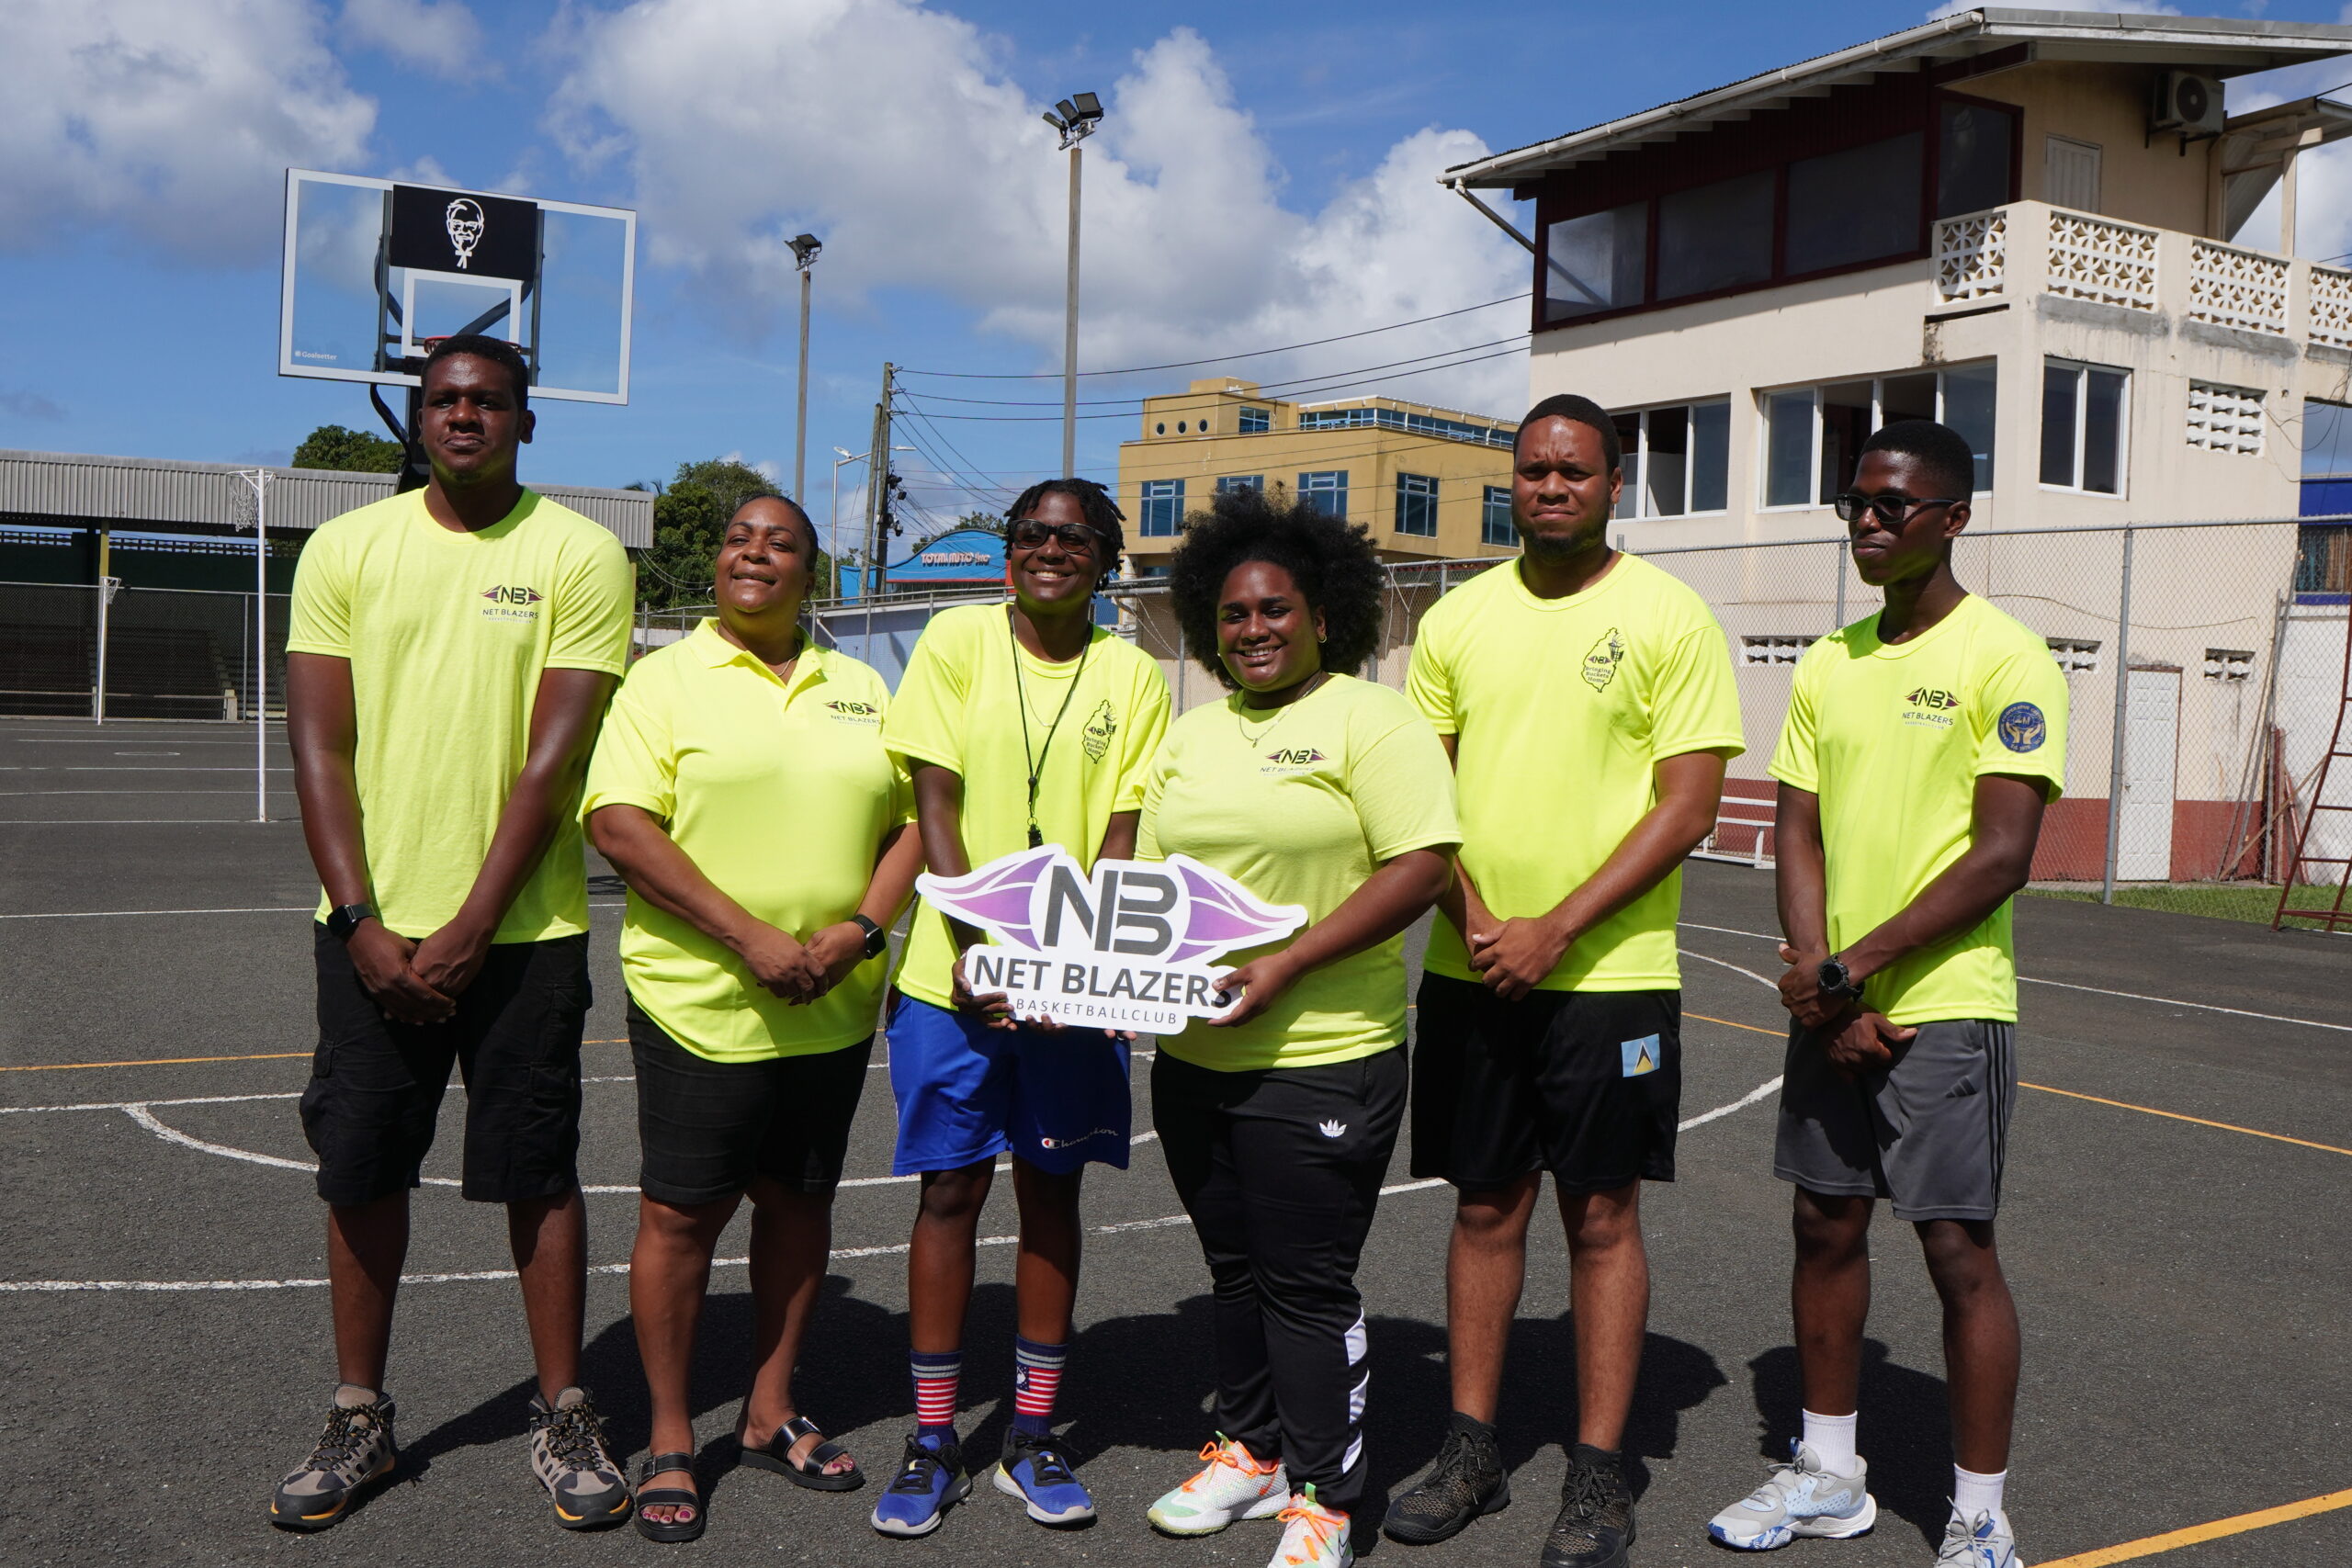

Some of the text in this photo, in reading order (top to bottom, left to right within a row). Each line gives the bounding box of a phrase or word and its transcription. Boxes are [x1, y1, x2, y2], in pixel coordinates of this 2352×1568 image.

[301, 351, 337, 361] Goalsetter
[921, 552, 948, 565] TOTAL
[949, 552, 974, 564] AUTO
[500, 586, 527, 605] NB
[482, 608, 538, 619] NET BLAZERS
[1917, 688, 1945, 708] NB
[847, 716, 881, 725] BLAZERS
[1916, 712, 1953, 726] BLAZERS
[1043, 865, 1178, 956] NB
[973, 954, 1232, 1009] NET BLAZERS
[1016, 998, 1178, 1025] BASKETBALLCLUB
